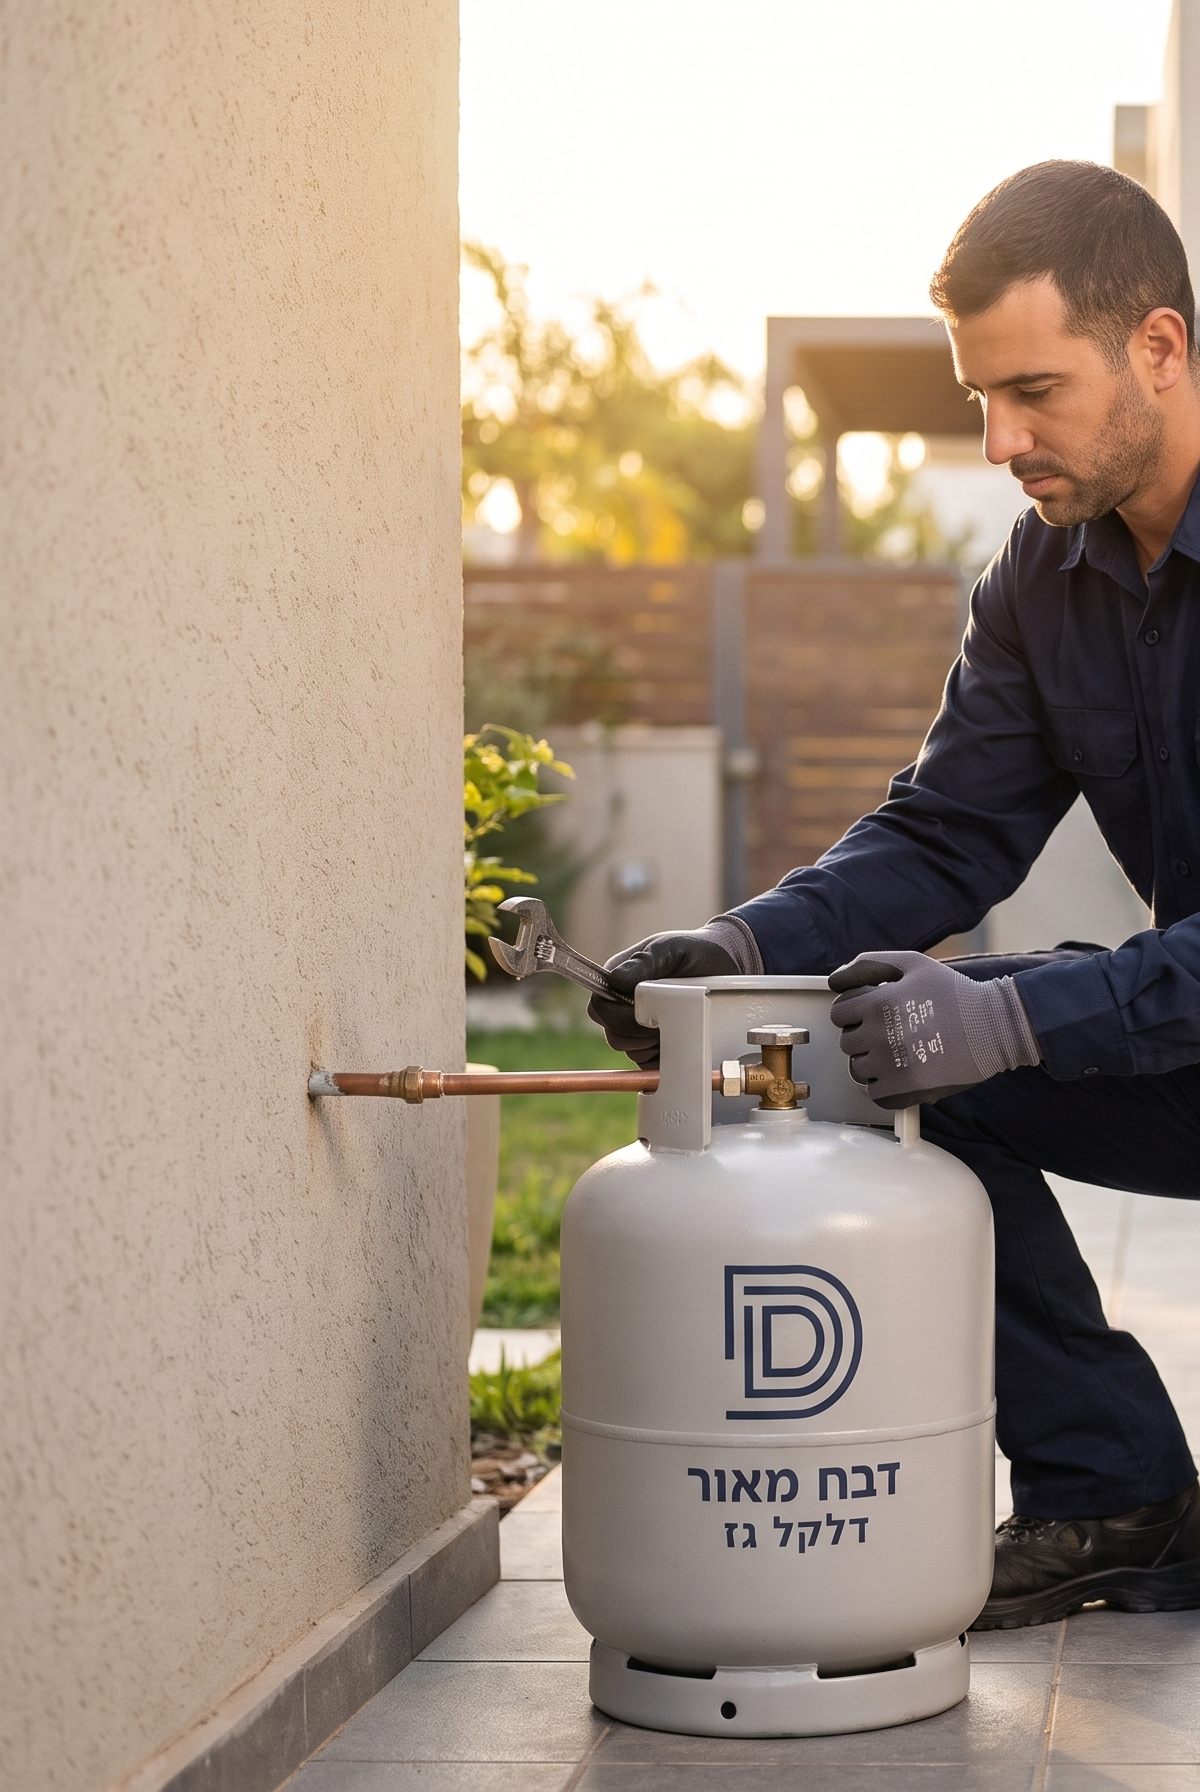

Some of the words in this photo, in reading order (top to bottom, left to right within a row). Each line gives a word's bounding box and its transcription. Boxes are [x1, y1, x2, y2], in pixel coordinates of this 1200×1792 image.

[687, 1467, 799, 1503] מאור
[818, 1461, 901, 1501] דבח
[724, 1522, 757, 1549] גז
[773, 1513, 869, 1554] דלקל
